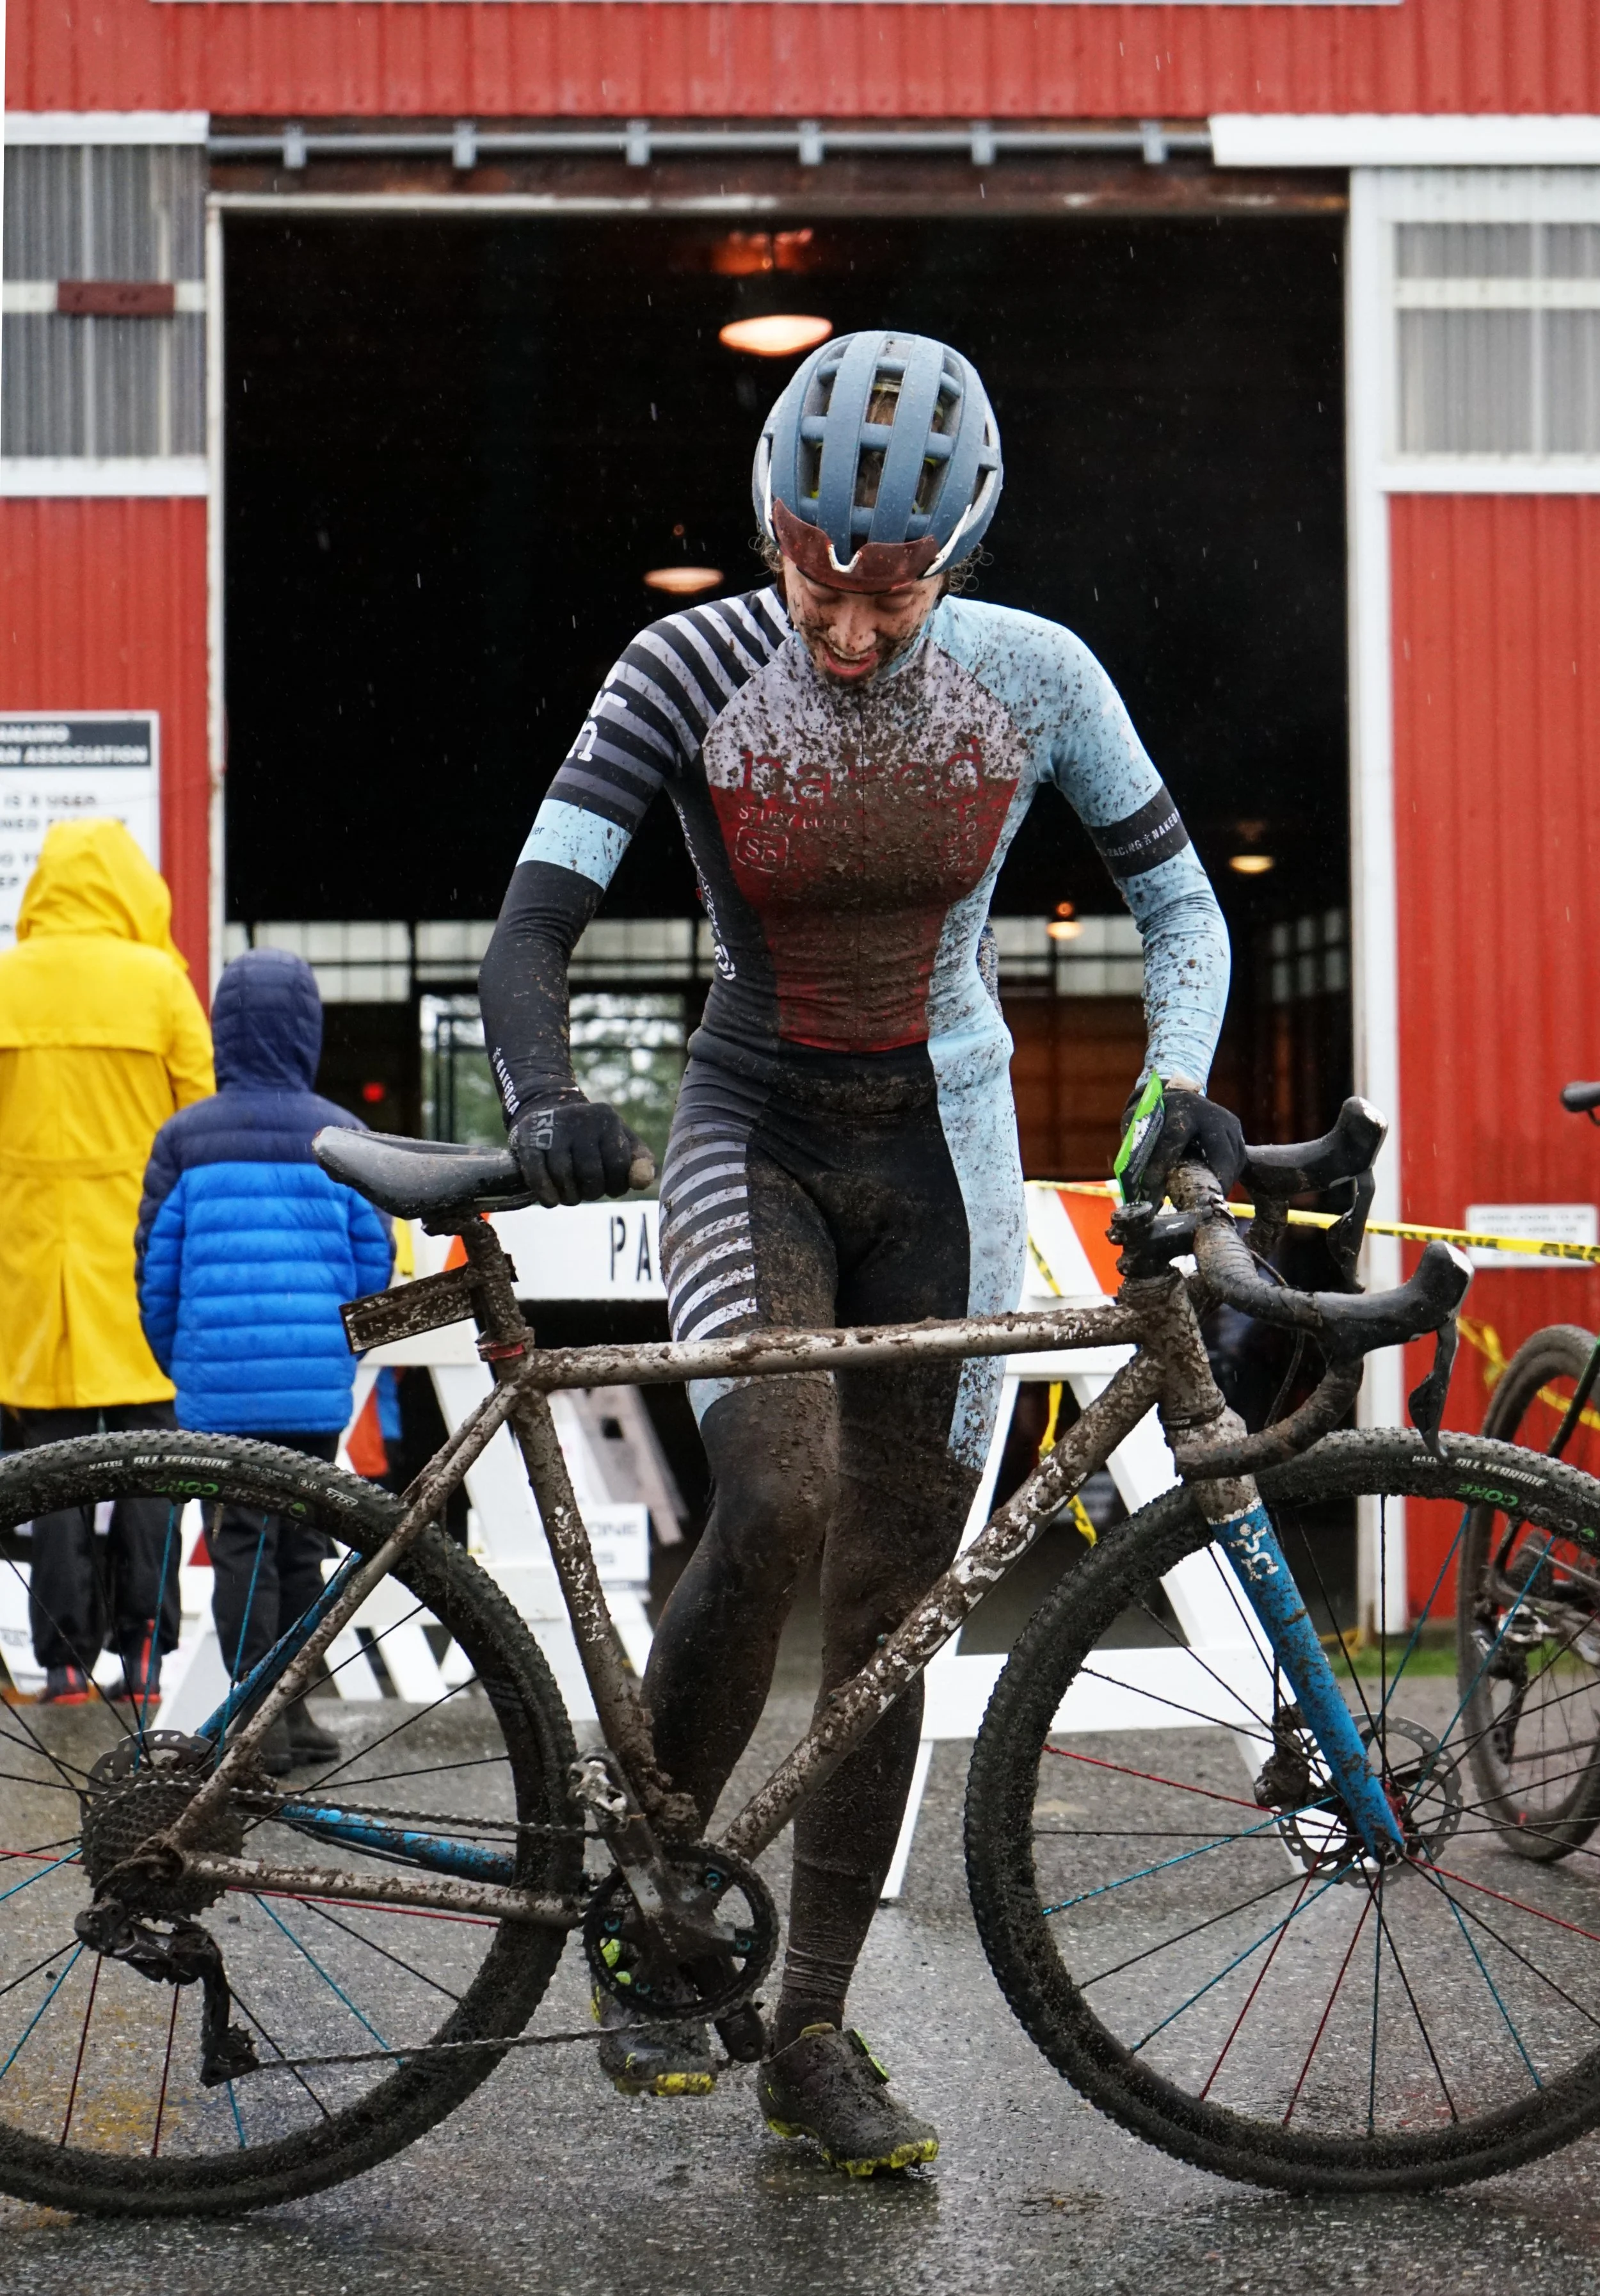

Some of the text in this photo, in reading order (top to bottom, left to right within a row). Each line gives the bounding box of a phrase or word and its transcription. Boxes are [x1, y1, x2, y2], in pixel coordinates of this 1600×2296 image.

[24, 745, 148, 763] ASSOCIATION
[611, 1213, 652, 1281] PA
[1455, 1483, 1519, 1506] CORE
